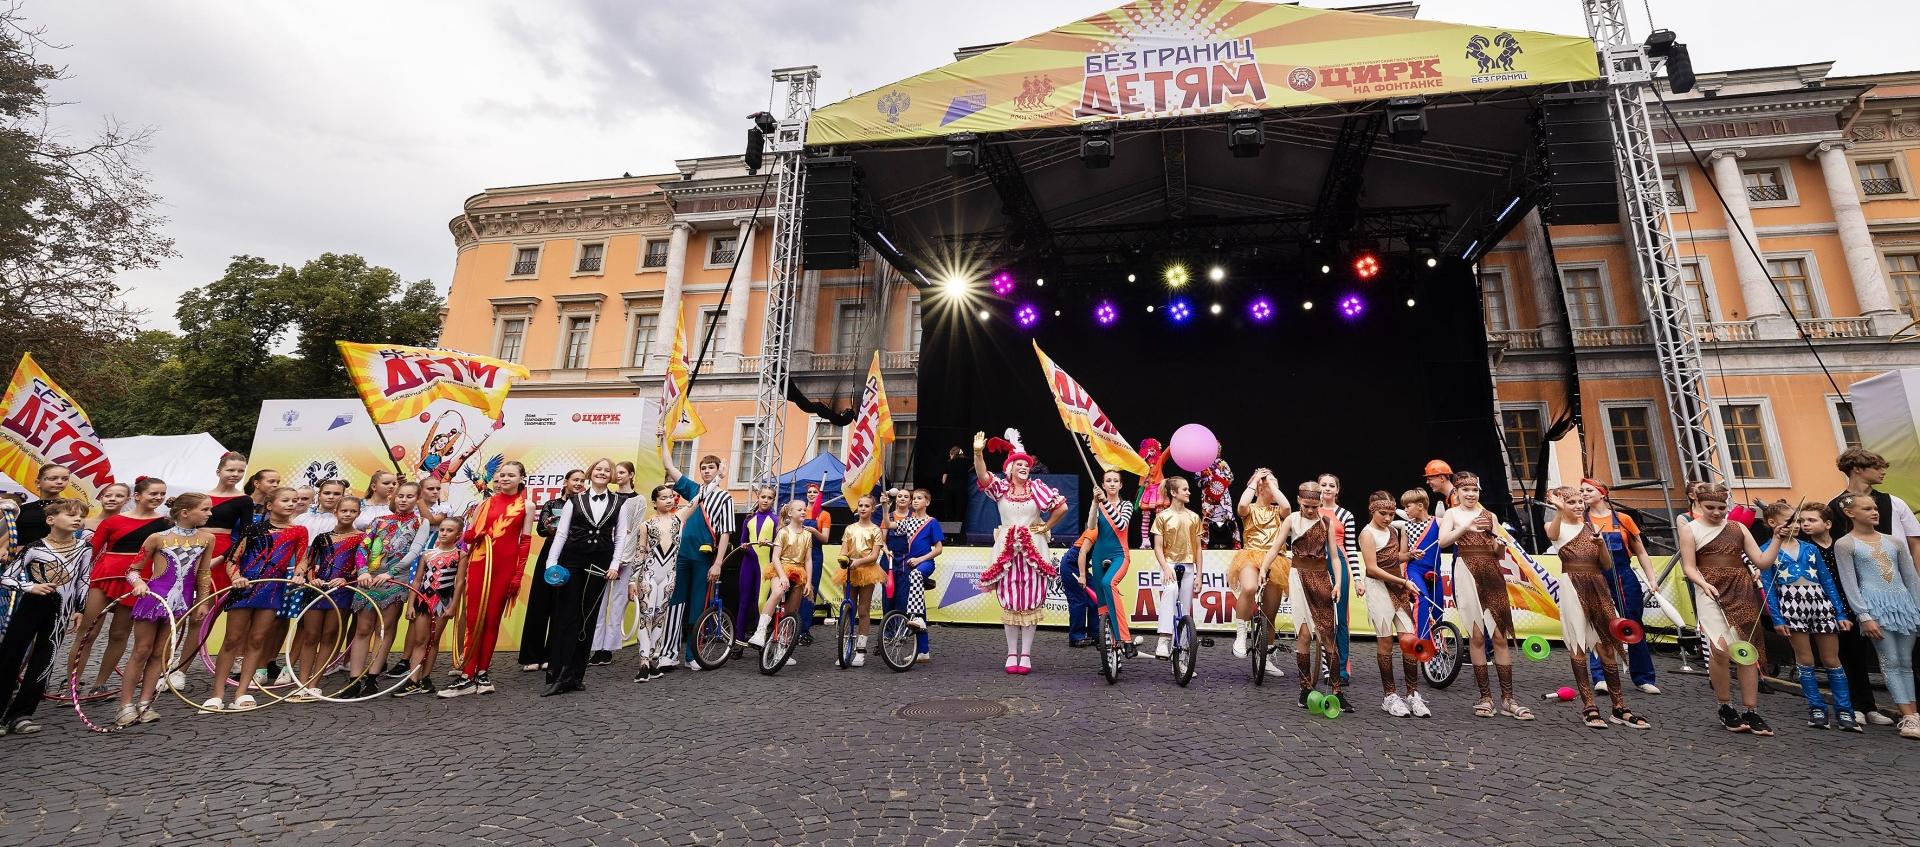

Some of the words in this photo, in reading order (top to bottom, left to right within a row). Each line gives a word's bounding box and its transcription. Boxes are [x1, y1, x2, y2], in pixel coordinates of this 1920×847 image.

[1086, 51, 1137, 74] БЕЗ
[1143, 39, 1255, 69] ГРАНИЦ
[1319, 58, 1442, 88] ЦИРК
[1353, 85, 1371, 95] НА
[1374, 78, 1444, 93] ФОНТАНКЕ
[1490, 72, 1528, 81] ГРАНИЦ
[1073, 63, 1267, 118] ДЕТЯМ
[2, 394, 115, 501] ДЕТЯМ
